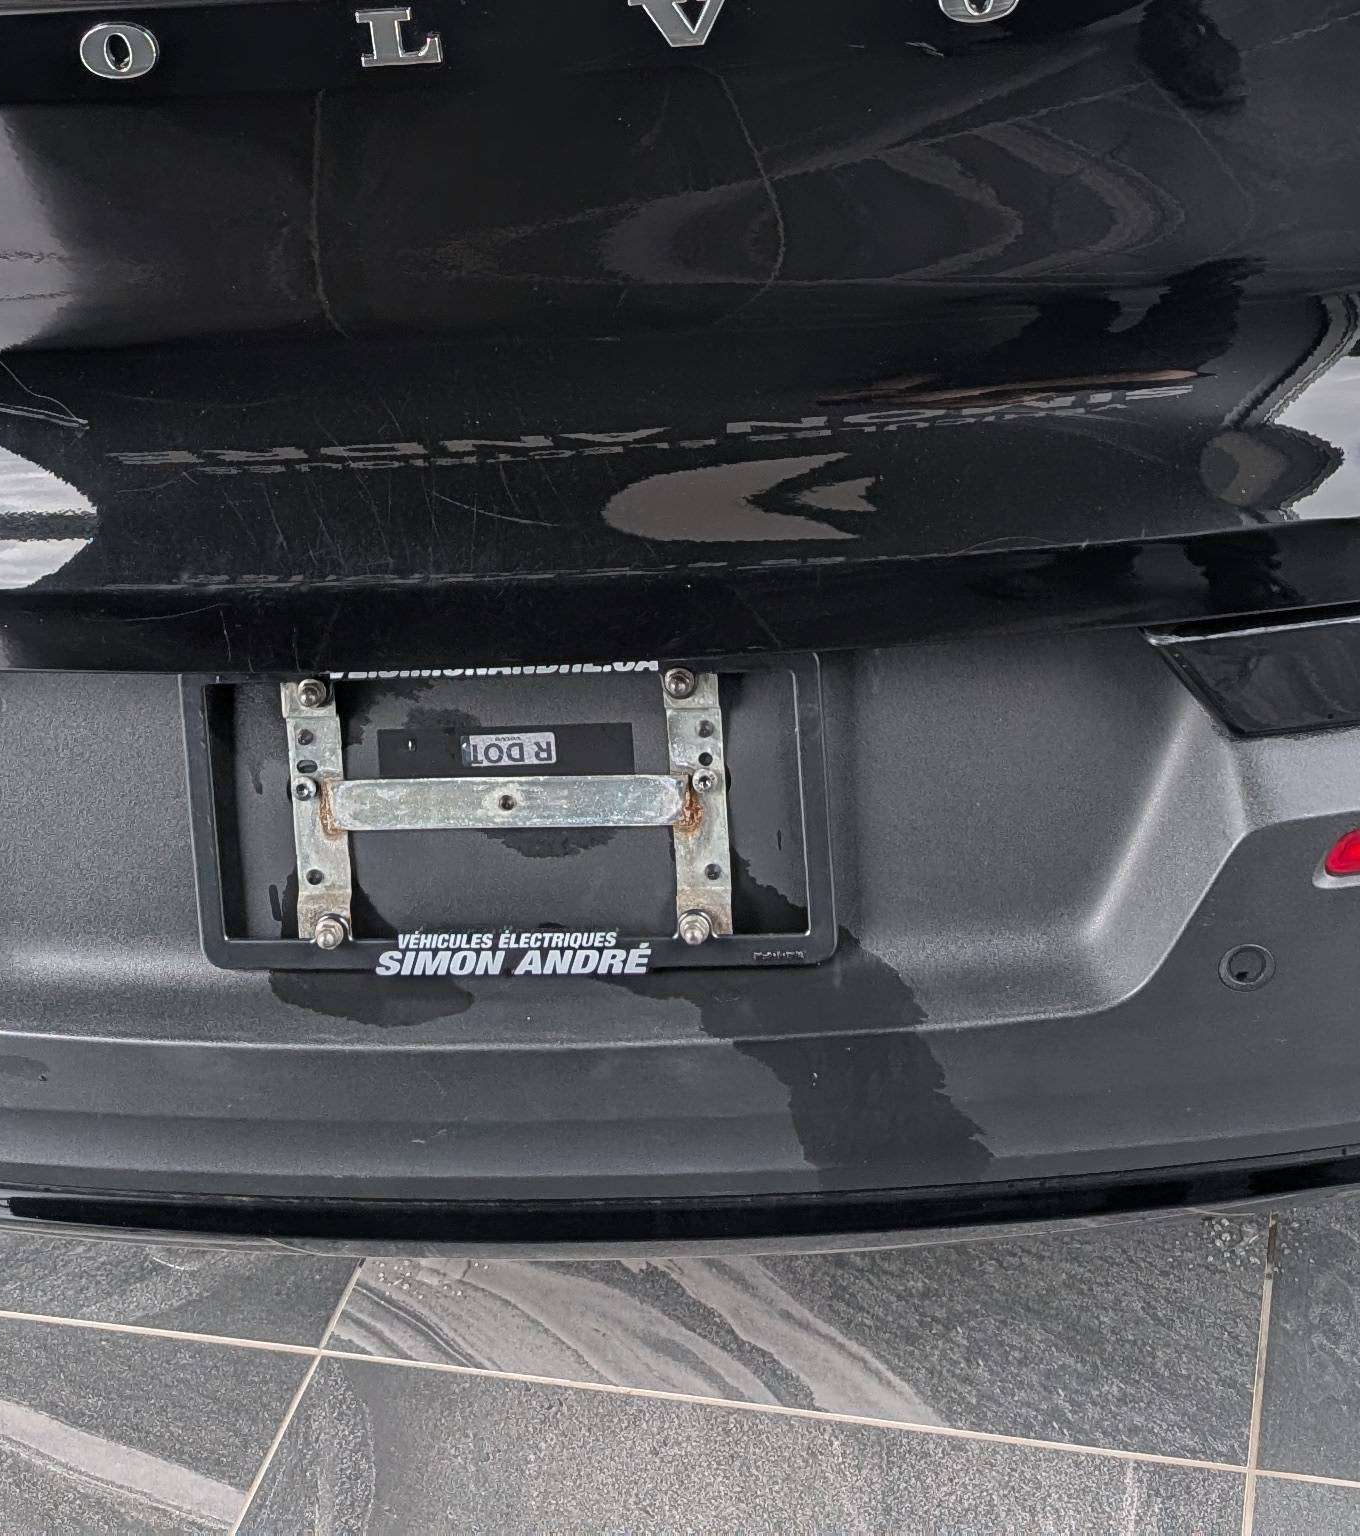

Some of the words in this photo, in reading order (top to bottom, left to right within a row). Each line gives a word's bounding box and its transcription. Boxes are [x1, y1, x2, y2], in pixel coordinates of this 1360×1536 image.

[397, 931, 493, 949] VÉHICULES
[498, 929, 618, 949] ÉLECTRIQUES
[375, 950, 506, 976] SIMON
[511, 942, 652, 975] ANDRÉ
